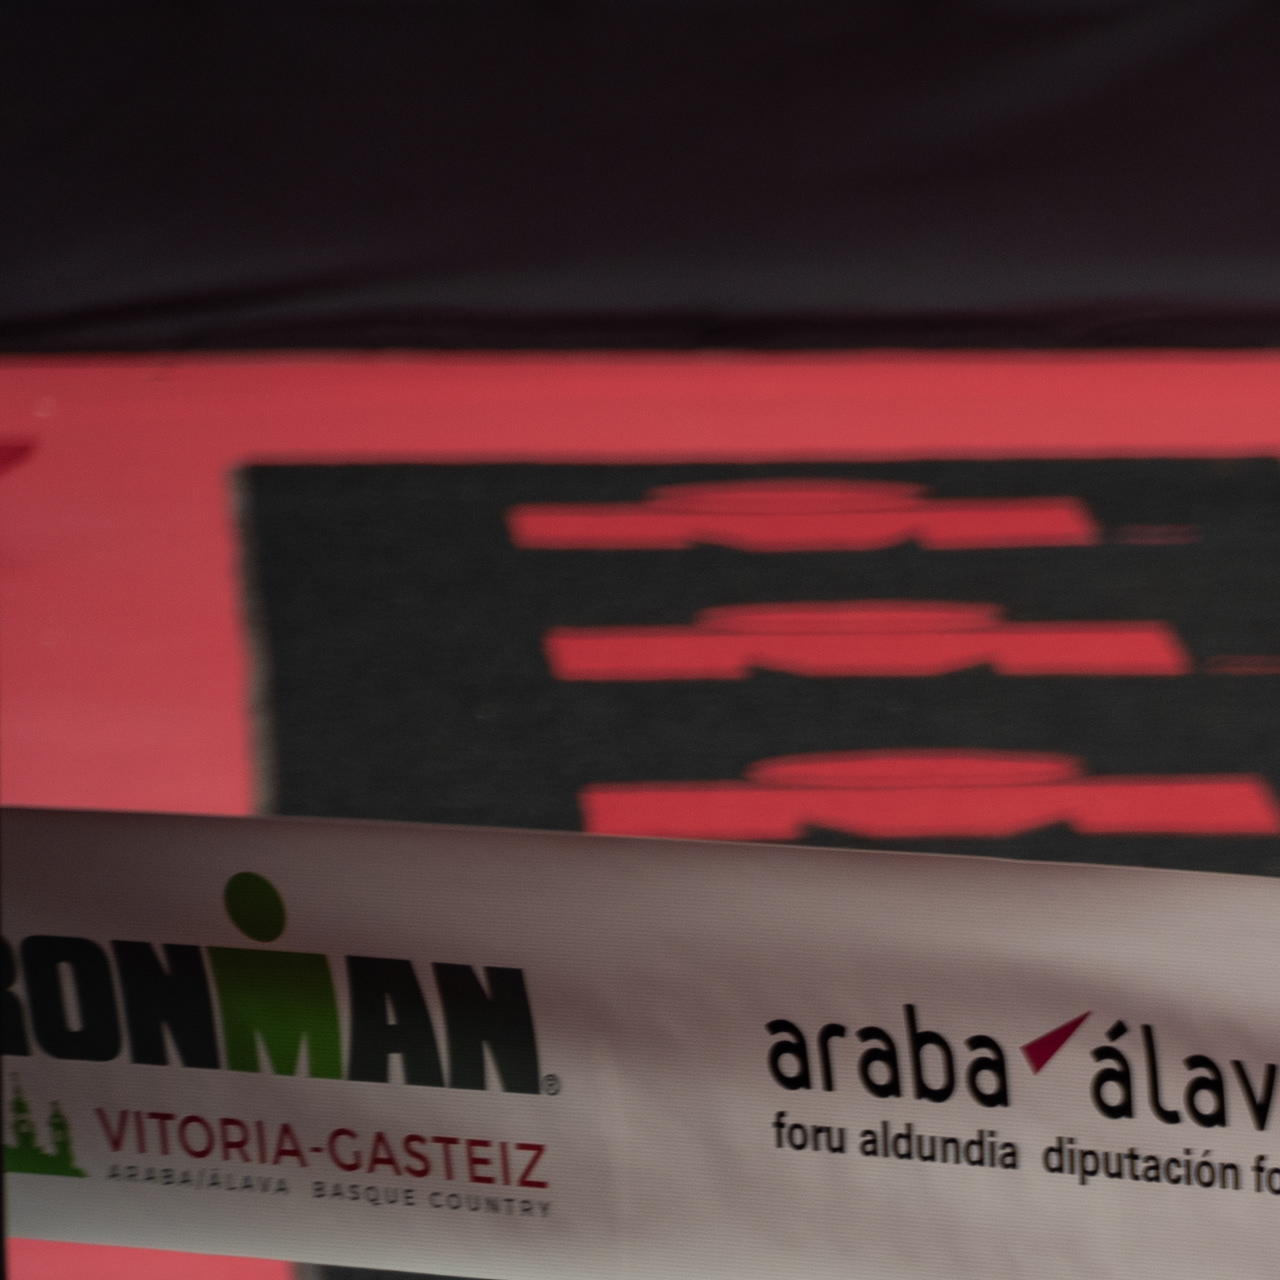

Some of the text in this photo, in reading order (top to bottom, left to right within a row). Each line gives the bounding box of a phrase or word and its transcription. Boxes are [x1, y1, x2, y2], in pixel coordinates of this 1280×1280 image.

[766, 1003, 1010, 1108] araba
[95, 1106, 550, 1190] VITORIA-GASTEIZ
[773, 1110, 846, 1154] foru
[859, 1120, 1020, 1170] aldundia
[1042, 1135, 1240, 1191] diputación
[311, 1181, 416, 1208] BASQUE
[428, 1190, 552, 1219] COUNTRY
